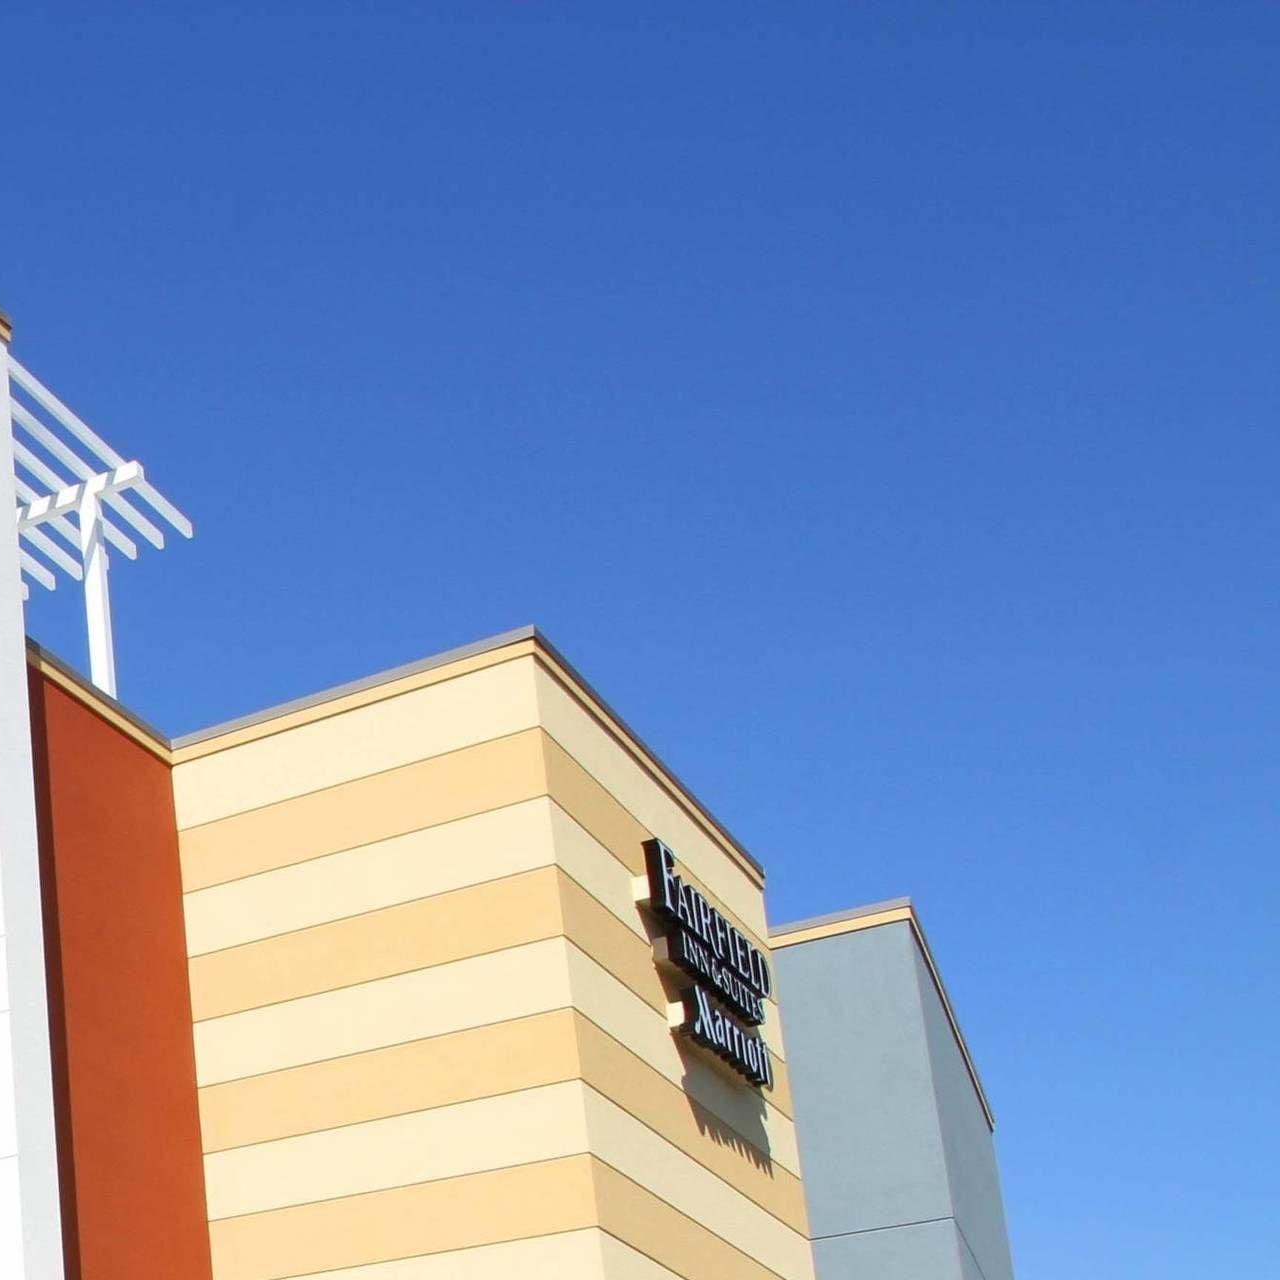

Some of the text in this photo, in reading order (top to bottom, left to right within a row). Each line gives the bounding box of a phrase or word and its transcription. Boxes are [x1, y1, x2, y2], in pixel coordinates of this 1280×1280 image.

[657, 838, 771, 998] FAIRFIELD
[681, 930, 711, 976] INN
[721, 967, 766, 1025] SUITES
[694, 984, 773, 1086] Marriott
